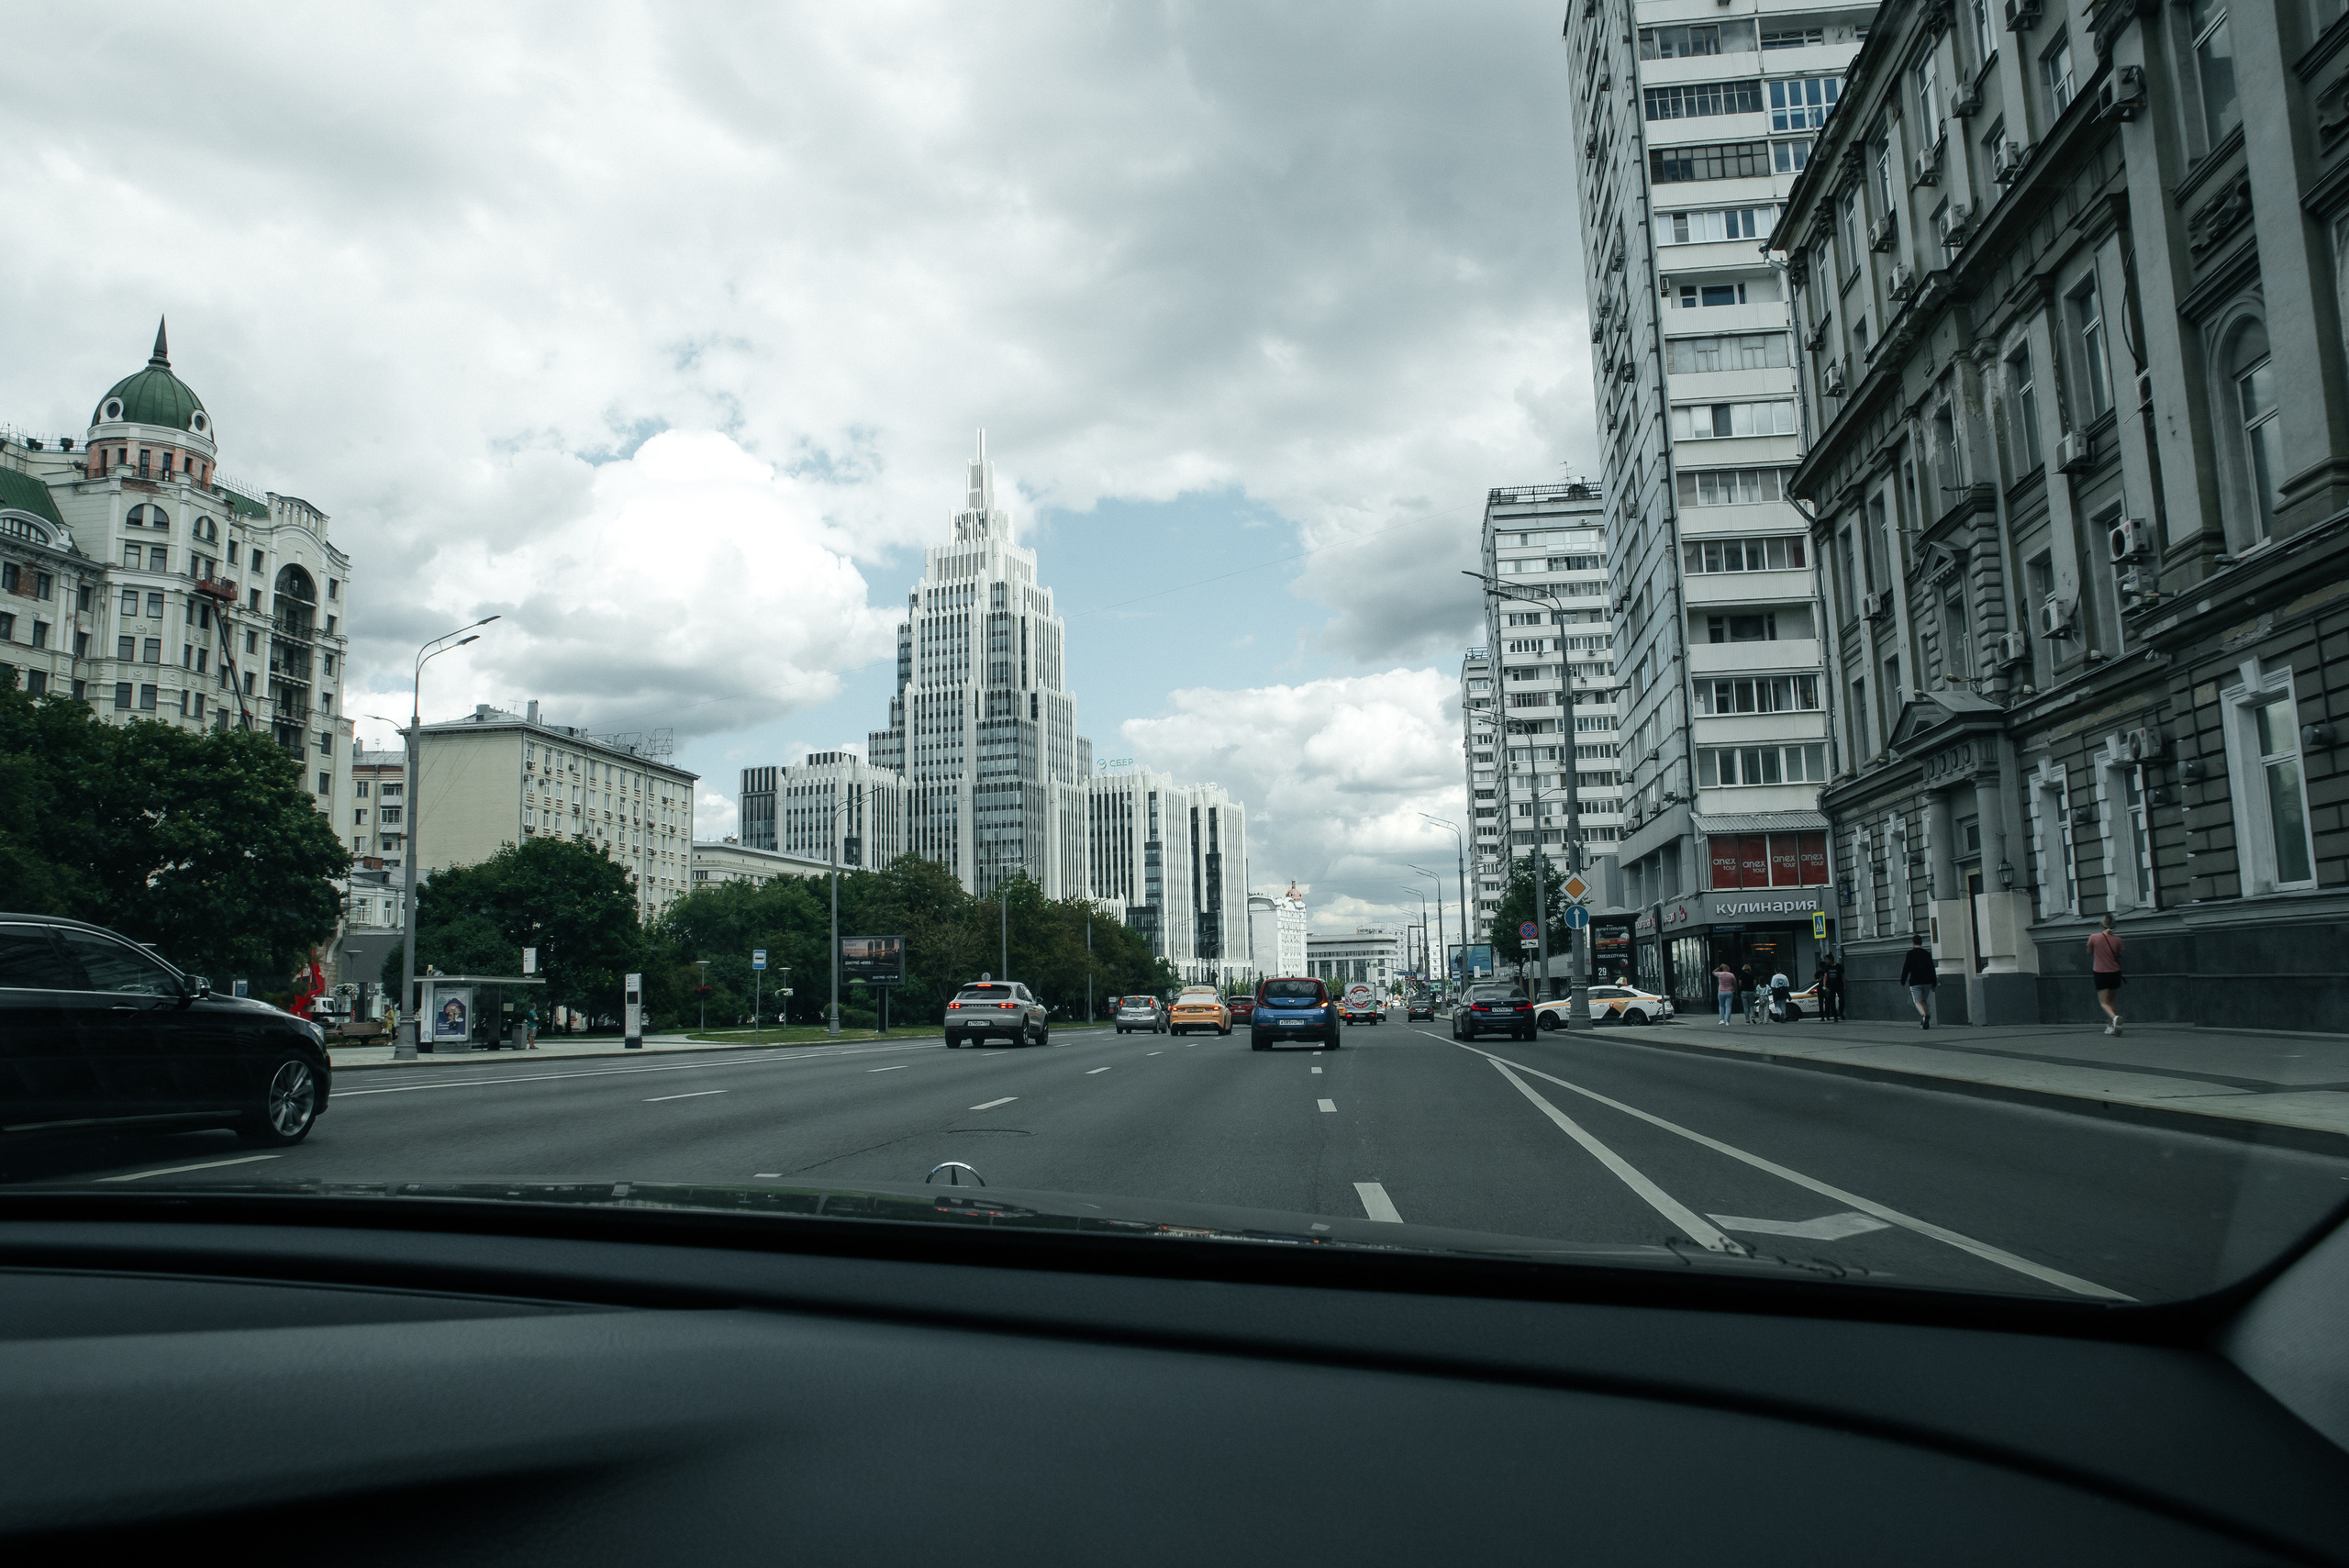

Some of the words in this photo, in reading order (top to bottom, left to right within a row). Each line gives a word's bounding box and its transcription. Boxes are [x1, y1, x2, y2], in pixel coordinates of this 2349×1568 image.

[1109, 758, 1134, 768] СБЕР
[1712, 858, 1736, 866] anex
[1800, 853, 1824, 862] anex
[1716, 900, 1817, 917] кулинария
[1598, 967, 1607, 976] 29
